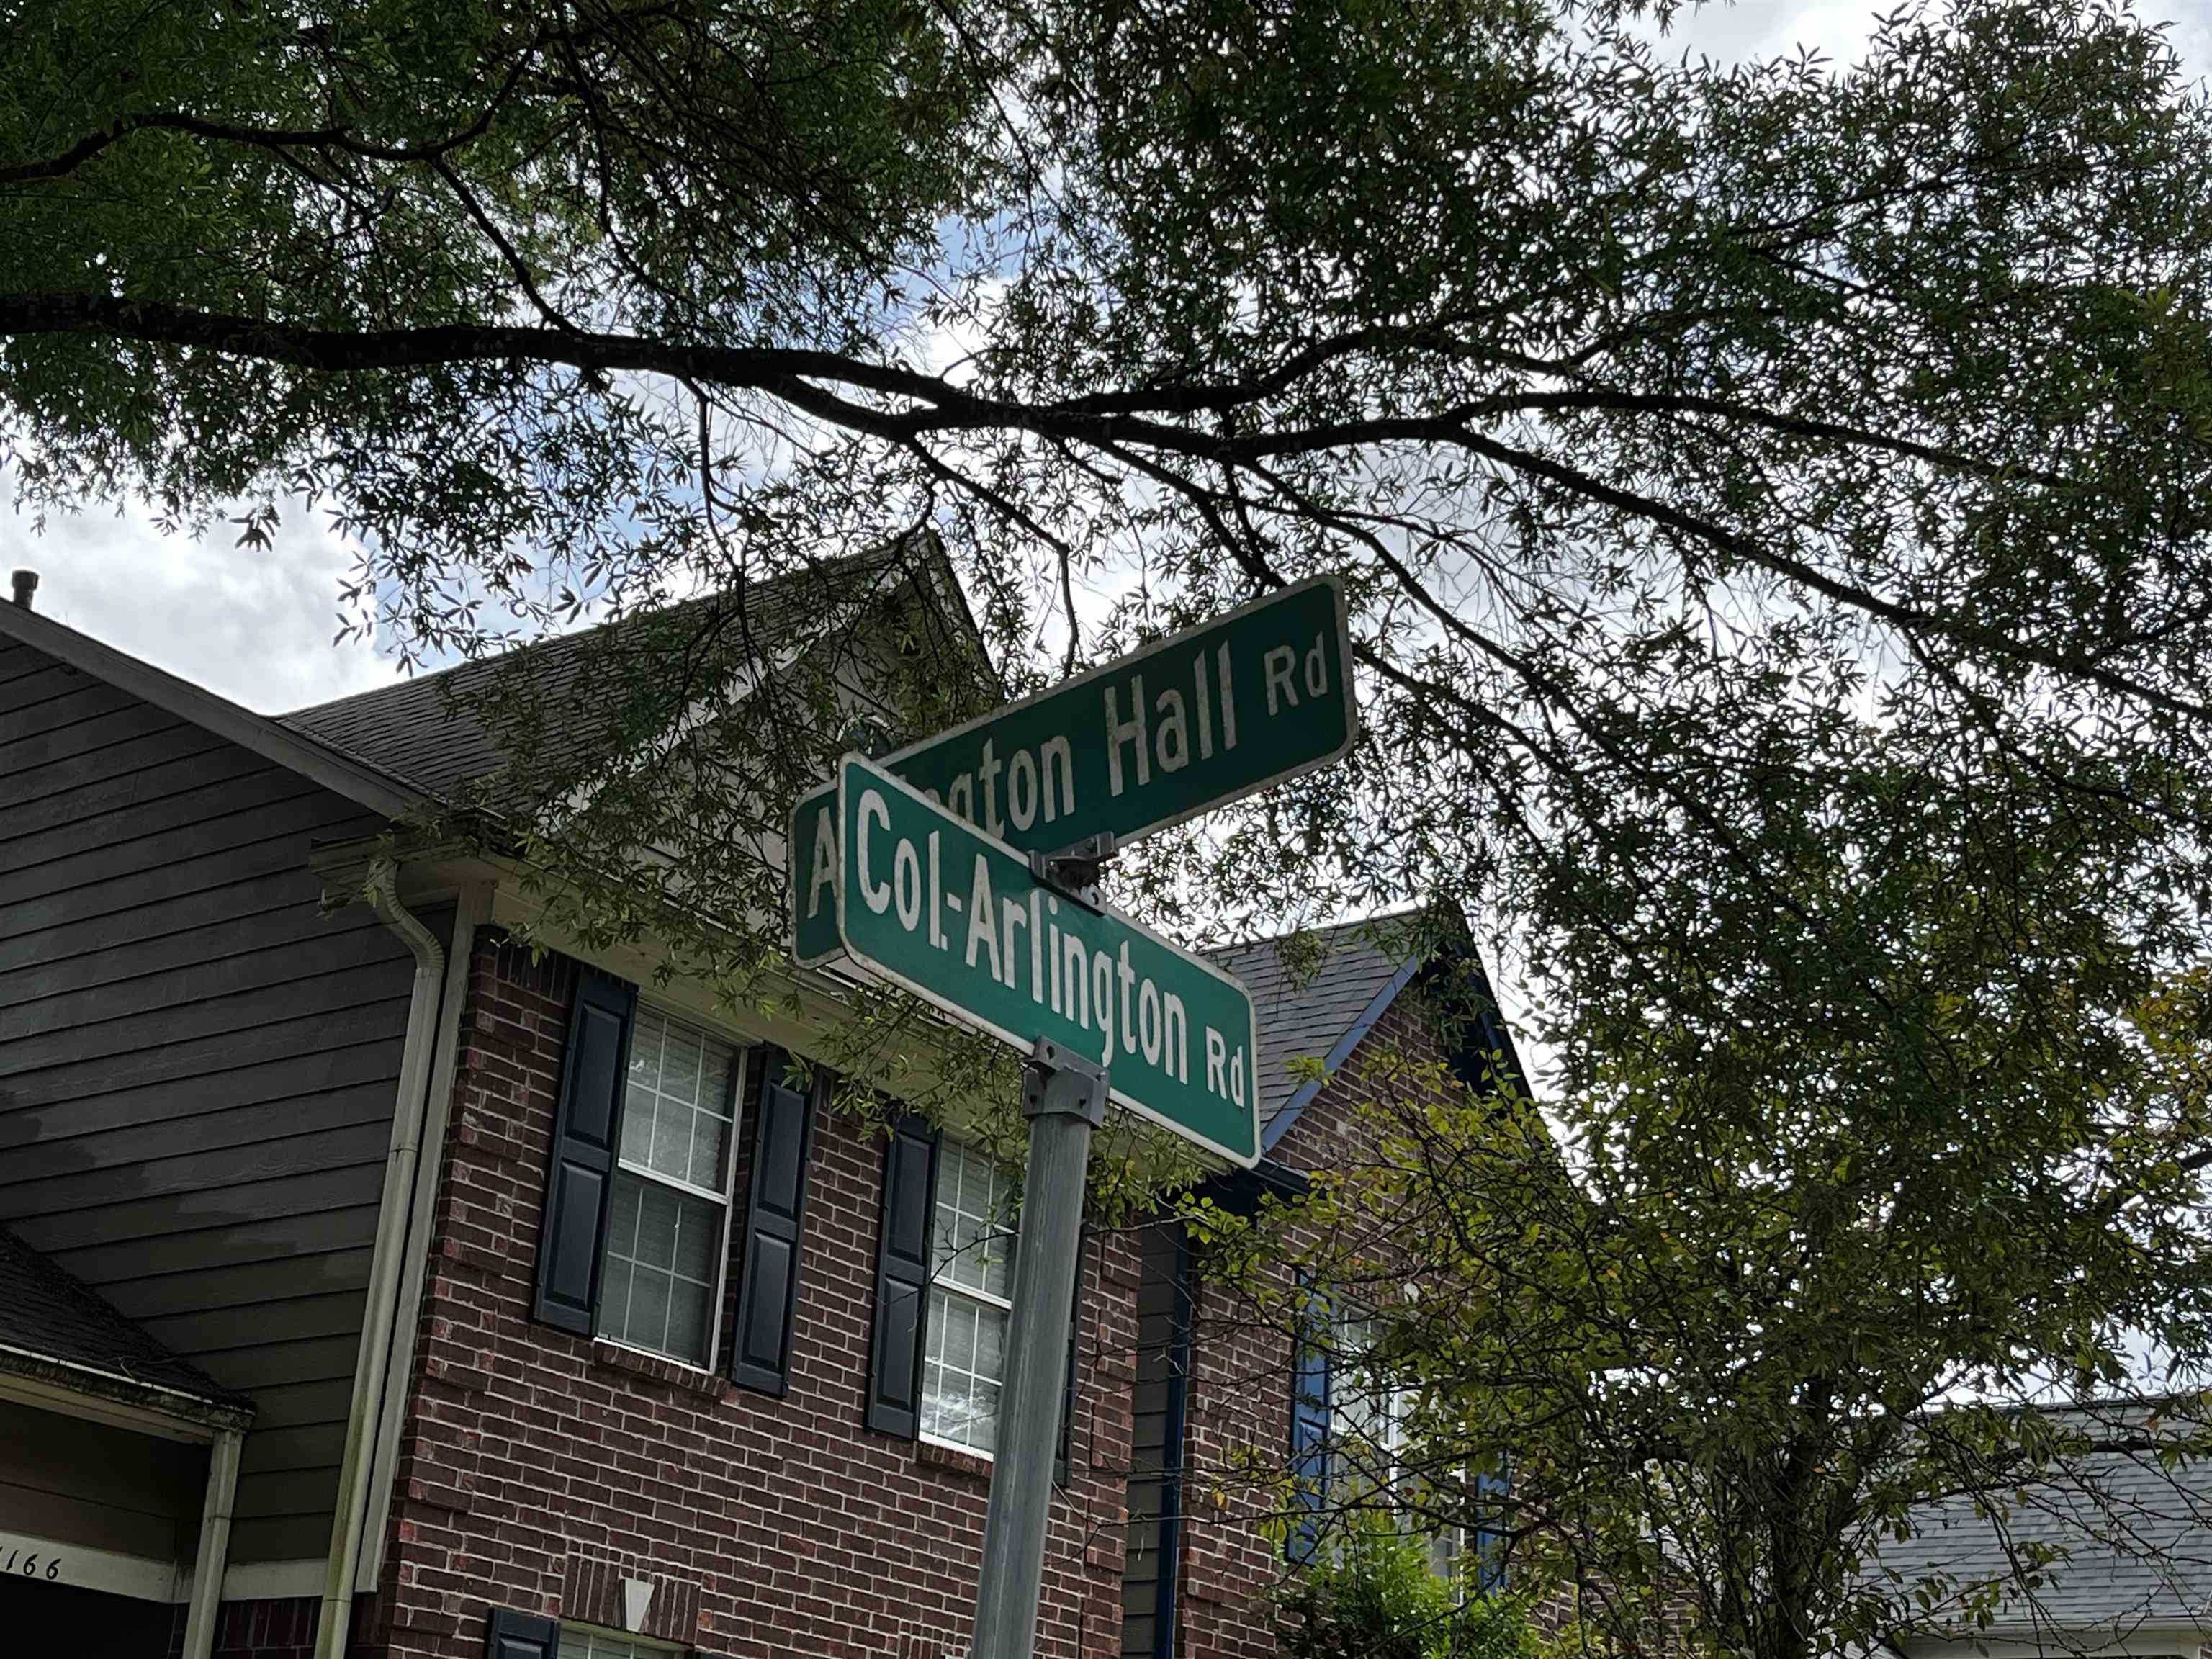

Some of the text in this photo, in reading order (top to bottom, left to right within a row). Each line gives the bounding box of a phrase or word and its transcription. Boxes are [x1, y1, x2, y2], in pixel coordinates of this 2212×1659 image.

[1104, 639, 1236, 797] Hall
[1264, 631, 1329, 717] Rd
[1205, 1025, 1245, 1110] Rd
[0, 1546, 62, 1580] 166
